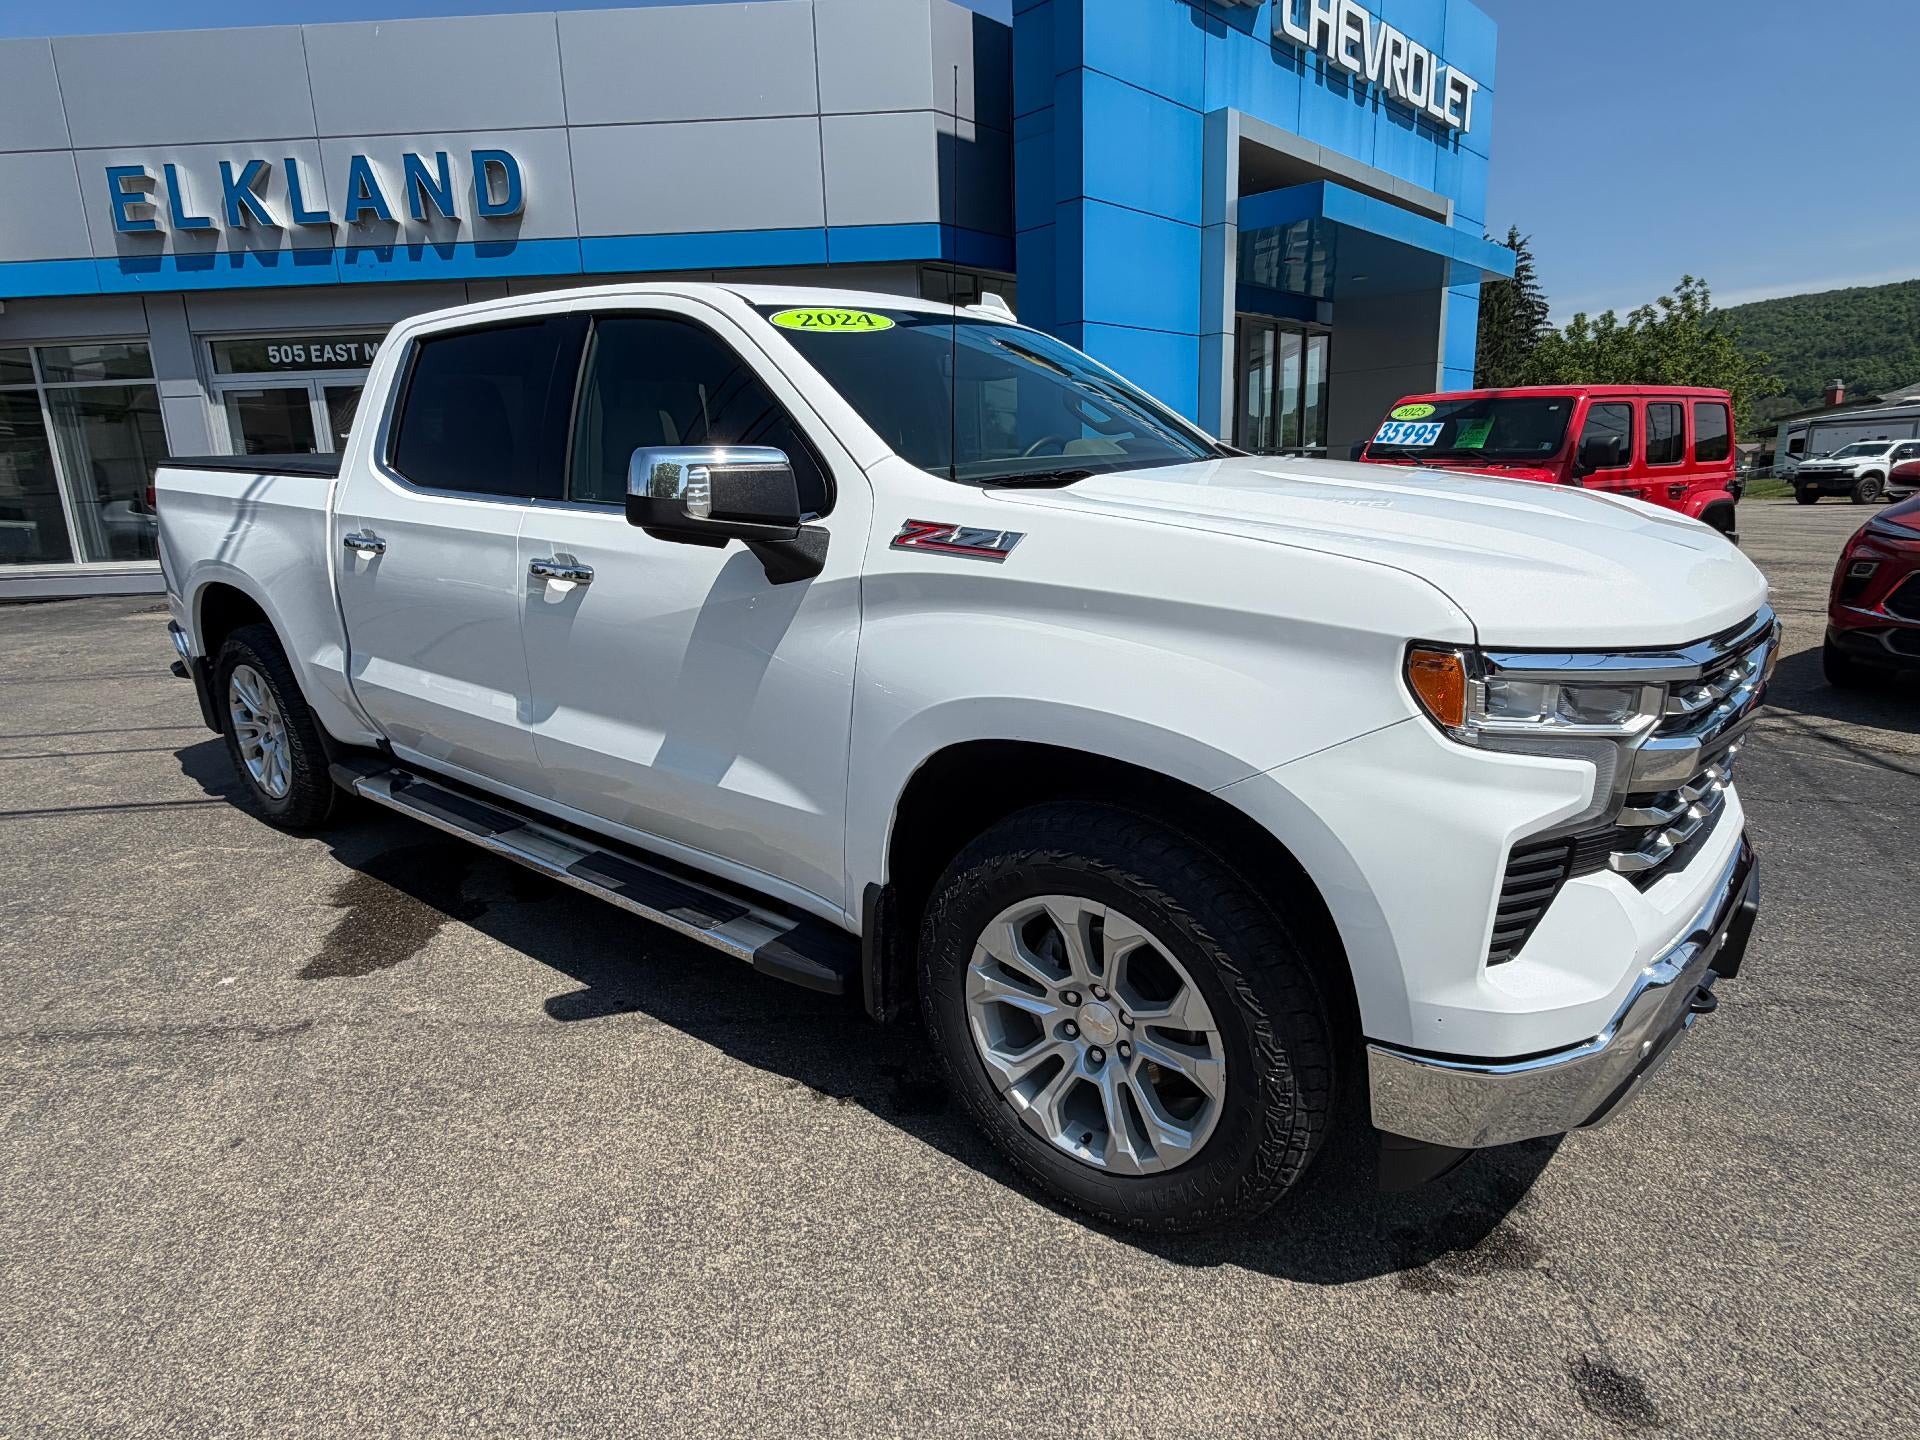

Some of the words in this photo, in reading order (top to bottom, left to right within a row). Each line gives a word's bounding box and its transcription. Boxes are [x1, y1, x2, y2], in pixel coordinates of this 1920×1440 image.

[1277, 0, 1479, 133] CHEVROLET
[105, 149, 526, 233] ELKLAND
[796, 312, 877, 327] 2024
[267, 344, 306, 364] 505
[310, 343, 359, 363] EAST
[1397, 407, 1427, 417] 2025
[1376, 423, 1442, 443] 35995
